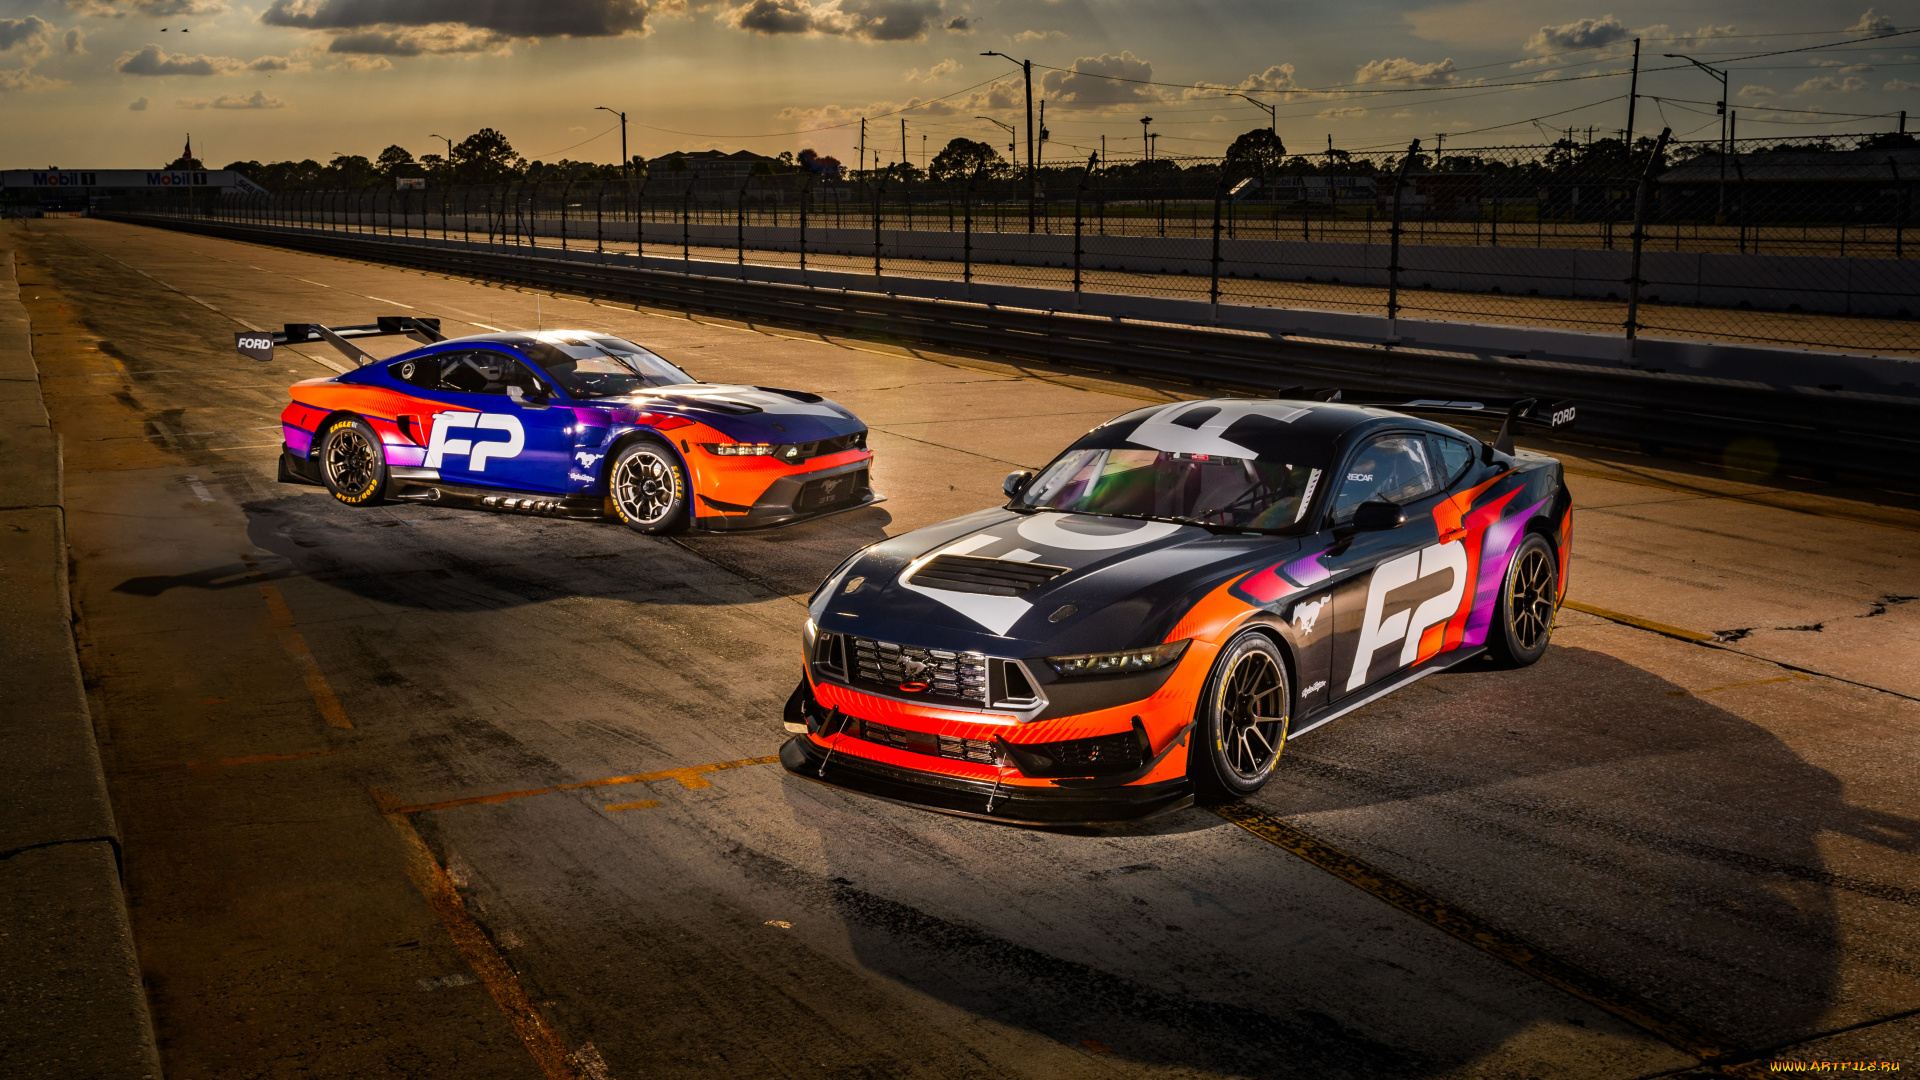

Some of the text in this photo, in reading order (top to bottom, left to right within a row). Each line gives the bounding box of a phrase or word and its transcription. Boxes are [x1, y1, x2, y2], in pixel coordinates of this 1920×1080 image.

[33, 172, 78, 186] Mobil
[147, 172, 191, 186] Mobil
[237, 336, 270, 350] FORD
[1552, 406, 1576, 427] FORD
[329, 420, 352, 434] EAGLE
[423, 410, 525, 472] FP
[671, 465, 682, 499] EAGLE
[1346, 540, 1468, 692] FP
